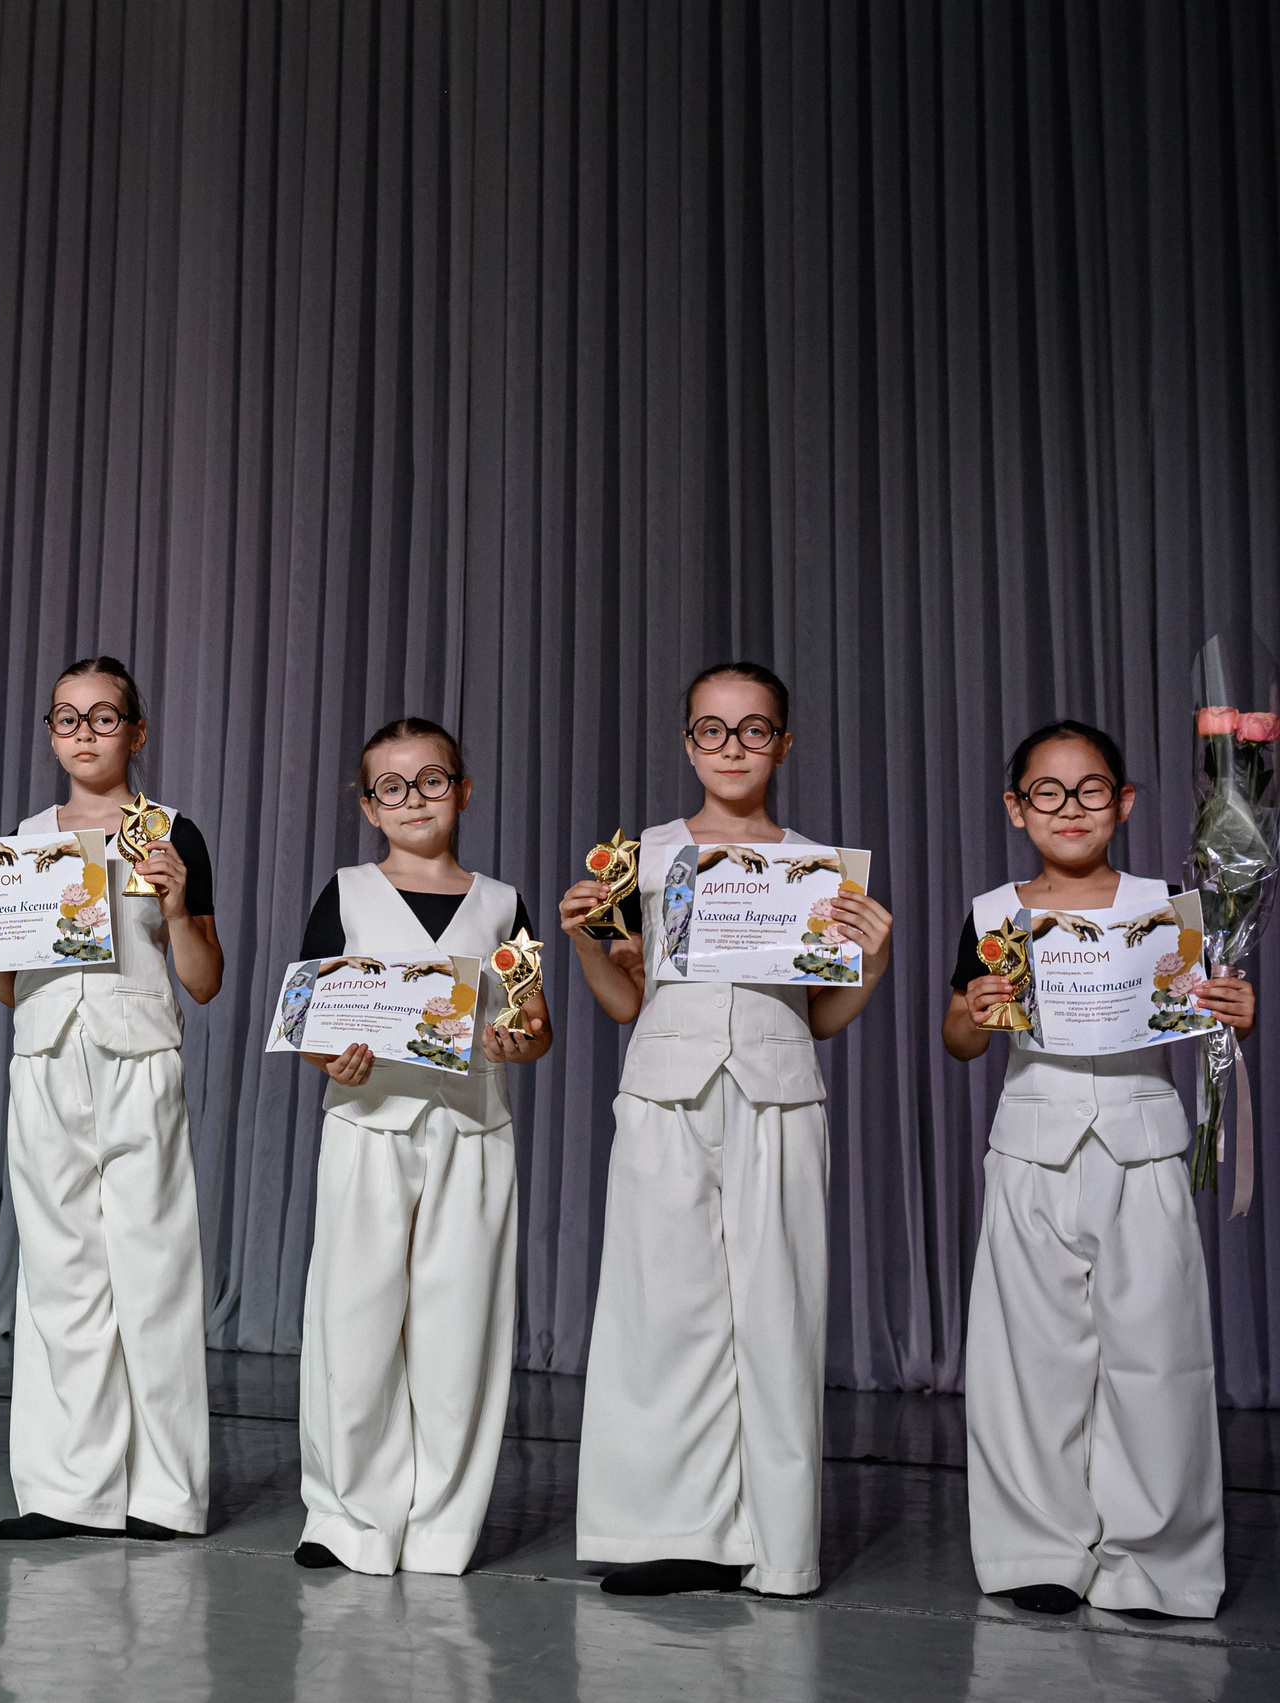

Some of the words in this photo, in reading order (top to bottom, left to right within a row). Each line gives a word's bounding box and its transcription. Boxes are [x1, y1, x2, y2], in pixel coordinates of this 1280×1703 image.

[702, 883, 769, 895] ДИПЛОМ
[20, 901, 58, 912] Ксения
[695, 910, 740, 921] Хахова
[745, 910, 797, 926] Варвара
[1041, 951, 1110, 965] ДИПЛОМ
[320, 981, 386, 991] ДИПЛОМ
[1041, 980, 1064, 992] Цой
[1069, 978, 1142, 992] Анастасия
[312, 1002, 369, 1010] Шалимова
[374, 1002, 428, 1016] Виктория
